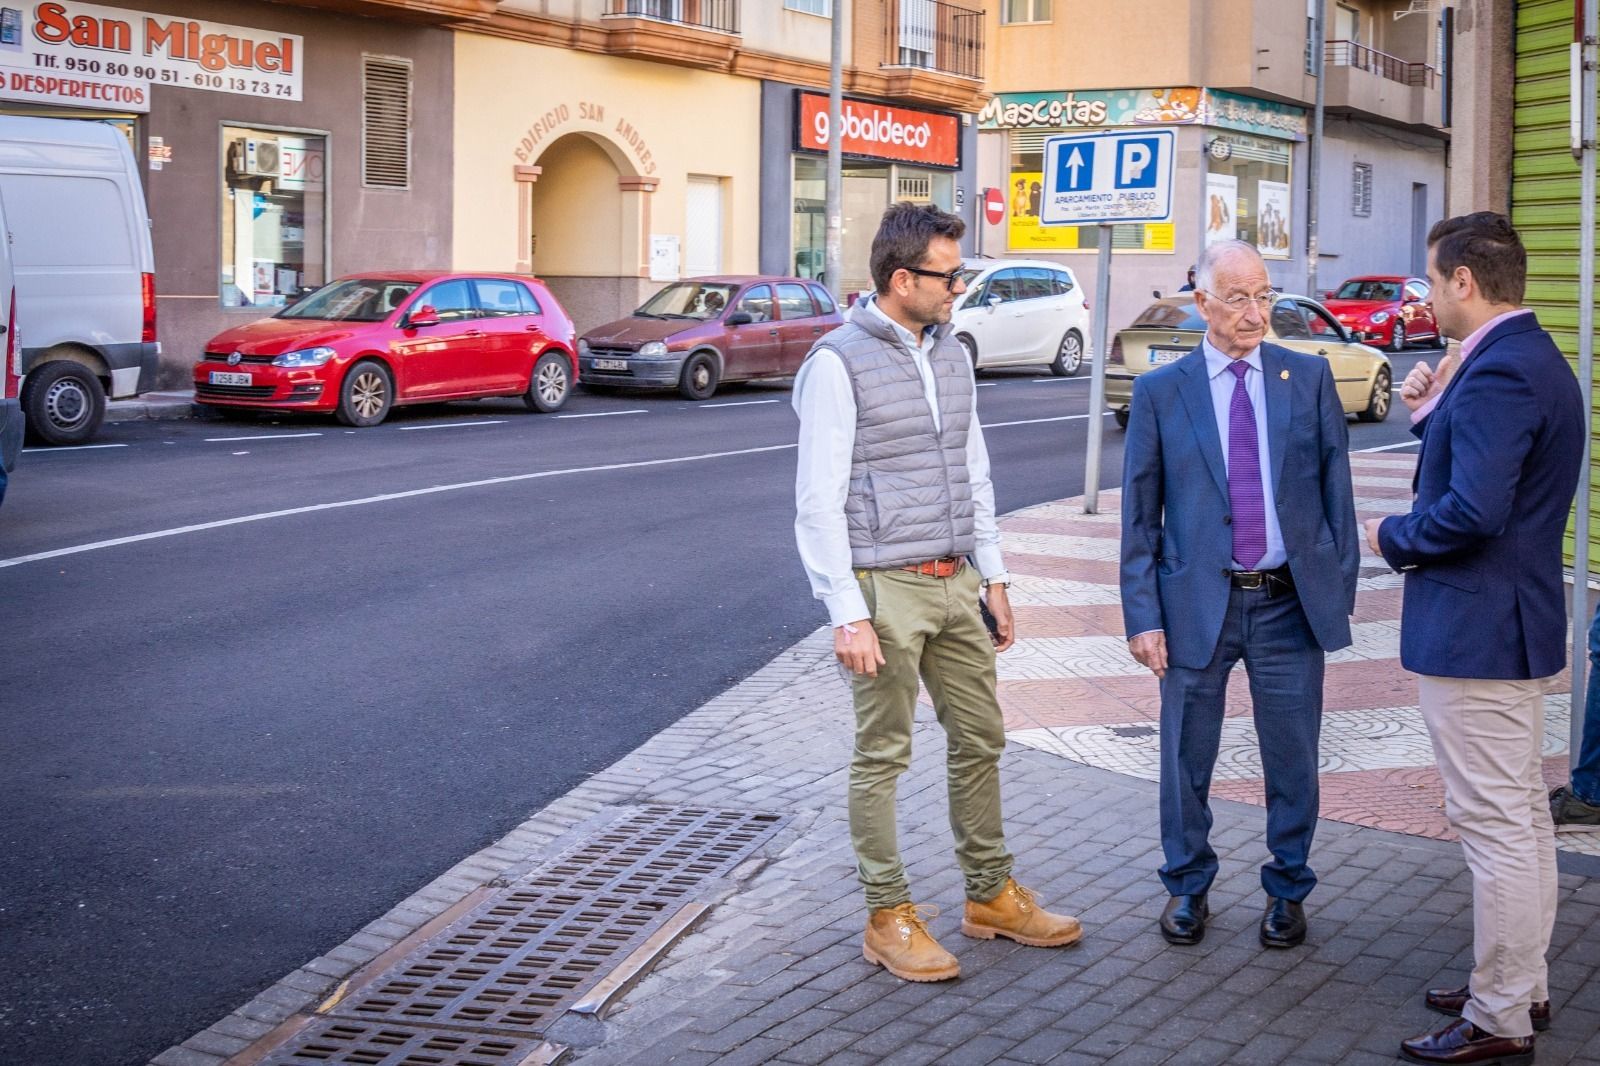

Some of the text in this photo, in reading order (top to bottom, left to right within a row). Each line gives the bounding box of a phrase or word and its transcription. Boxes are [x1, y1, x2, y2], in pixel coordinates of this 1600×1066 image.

[33, 2, 293, 74] San Miguel
[10, 73, 145, 104] DESPERFECTOS
[32, 53, 59, 69] Tlf.
[65, 57, 101, 73] 950
[106, 62, 129, 76] 80
[134, 66, 156, 80] 90
[161, 69, 179, 82] 51
[194, 74, 222, 88] 610
[229, 77, 246, 91] 13
[252, 81, 270, 94] 73
[275, 84, 292, 96] 74
[978, 92, 1107, 126] Mascotas
[515, 102, 657, 174] EDIFICIO SAN ANDRES
[1121, 143, 1151, 184] P
[1055, 193, 1113, 204] APARCAMIENTO
